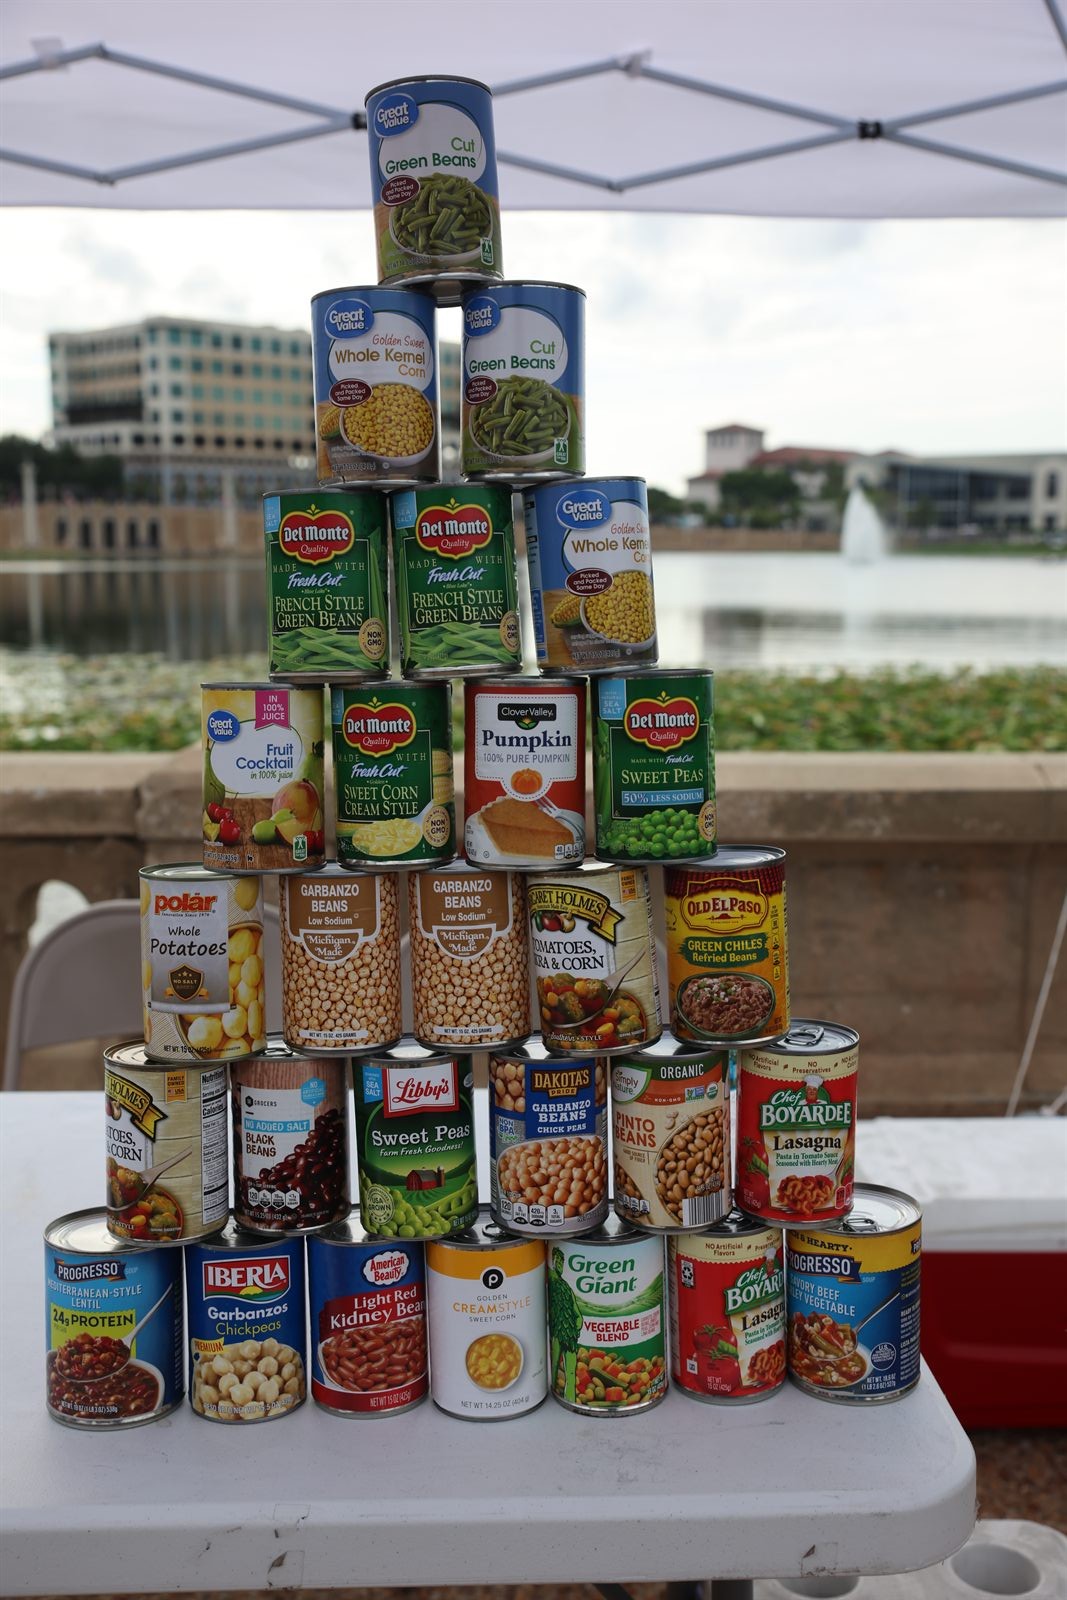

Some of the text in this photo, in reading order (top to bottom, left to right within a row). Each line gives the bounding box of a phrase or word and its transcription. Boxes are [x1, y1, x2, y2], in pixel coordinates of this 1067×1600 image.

[377, 102, 409, 122] Great
[384, 115, 411, 129] Value
[451, 137, 475, 153] Cut
[385, 152, 477, 175] Green Beans
[329, 307, 365, 323] Great
[465, 305, 493, 321] Great
[335, 321, 365, 332] Value
[470, 318, 492, 330] Value
[372, 334, 426, 348] Golden Sweet
[530, 340, 555, 354] Cut
[335, 347, 426, 364] Whole Kernel
[397, 364, 426, 378] Corn
[469, 355, 556, 374] Green Beans
[562, 499, 602, 514] Great
[572, 511, 603, 522] Value
[284, 526, 349, 542] Del Monte
[421, 519, 488, 538] Del Monte
[300, 543, 329, 555] Quality
[440, 538, 470, 549] Quality
[273, 562, 365, 574] MADE WITH
[287, 572, 347, 590] Fresh Cut
[427, 566, 488, 585] Fresh Cut
[275, 594, 365, 613] FRENCH STYLE
[413, 588, 504, 609] FRENCH STYLE
[276, 611, 363, 629] GREEN BEANS
[415, 604, 503, 625] GREEN BEANS
[501, 707, 551, 717] Clover Valley
[210, 718, 232, 729] Great
[347, 719, 411, 734] Del Monte
[631, 712, 695, 728] Del Monte
[214, 727, 232, 736] Value
[650, 732, 678, 742] Quality
[363, 736, 390, 747] Quality
[482, 730, 572, 753] Pumpkin
[267, 744, 293, 756] Fruit
[236, 757, 293, 770] Cocktail
[484, 753, 570, 763] 100% PURE PUMPKIN
[250, 770, 293, 782] in 100% juice
[351, 763, 408, 778] Fresh Cut
[621, 768, 703, 784] SWEET PEAS
[344, 784, 418, 800] SWEET CORN
[624, 792, 703, 804] 50% LESS SODIUM
[345, 801, 418, 815] CREAM STYLE
[301, 884, 359, 897] GARBANZO
[433, 880, 492, 893] GARBANZO
[312, 900, 348, 912] BEANS
[445, 896, 481, 909] BEANS
[309, 916, 352, 925] Low Sodium
[442, 912, 485, 921] Low Sodium
[168, 926, 200, 937] Whole
[440, 930, 484, 942] Michigan
[151, 938, 227, 956] Potatoes
[307, 935, 351, 947] Michigan
[449, 943, 477, 952] Made
[688, 938, 762, 952] GREEN CHILES
[315, 947, 343, 956] Made
[693, 953, 757, 963] Refried Beans
[660, 1063, 704, 1079] ORGANIC
[366, 1080, 379, 1088] SEA
[535, 1069, 590, 1088] DAKOTA'S
[110, 1080, 146, 1110] HOLMES
[365, 1088, 380, 1097] SALT
[392, 1077, 449, 1104] Libby's
[550, 1088, 576, 1096] PRIDE
[771, 1089, 802, 1106] Chef
[532, 1099, 591, 1113] GARBANZO
[538, 1110, 587, 1123] BEANS
[761, 1102, 851, 1127] BOYARDEE
[245, 1120, 308, 1132] NO ADDED SALT
[499, 1118, 514, 1127] NON
[537, 1123, 587, 1133] CHICK PEAS
[616, 1111, 655, 1133] PINTO
[371, 1125, 470, 1146] Sweet Peas
[499, 1124, 515, 1136] BPA
[246, 1132, 275, 1146] BLACK
[615, 1128, 656, 1148] BEANS
[774, 1135, 842, 1152] Lasagna
[111, 1142, 142, 1162] CORN
[247, 1144, 276, 1158] BEANS
[370, 1256, 405, 1271] American
[568, 1254, 635, 1273] Green
[58, 1262, 118, 1281] PROGRESSO
[207, 1261, 287, 1288] IBERIA
[374, 1267, 403, 1282] Beauty
[737, 1267, 763, 1287] Chef
[576, 1276, 637, 1294] Giant
[71, 1297, 101, 1309] LENTIL
[354, 1286, 417, 1310] Light Red
[453, 1296, 531, 1314] CREAMSTYLE
[53, 1308, 133, 1328] 24g PROTEIN
[208, 1303, 288, 1321] Garbanzos
[496, 1314, 516, 1322] CORN
[215, 1320, 281, 1338] Chickpeas
[584, 1319, 640, 1333] VEGETABLE
[596, 1332, 629, 1342] BLEND
[194, 1340, 223, 1353] PREMIUM
[486, 1401, 502, 1409] 14.25
